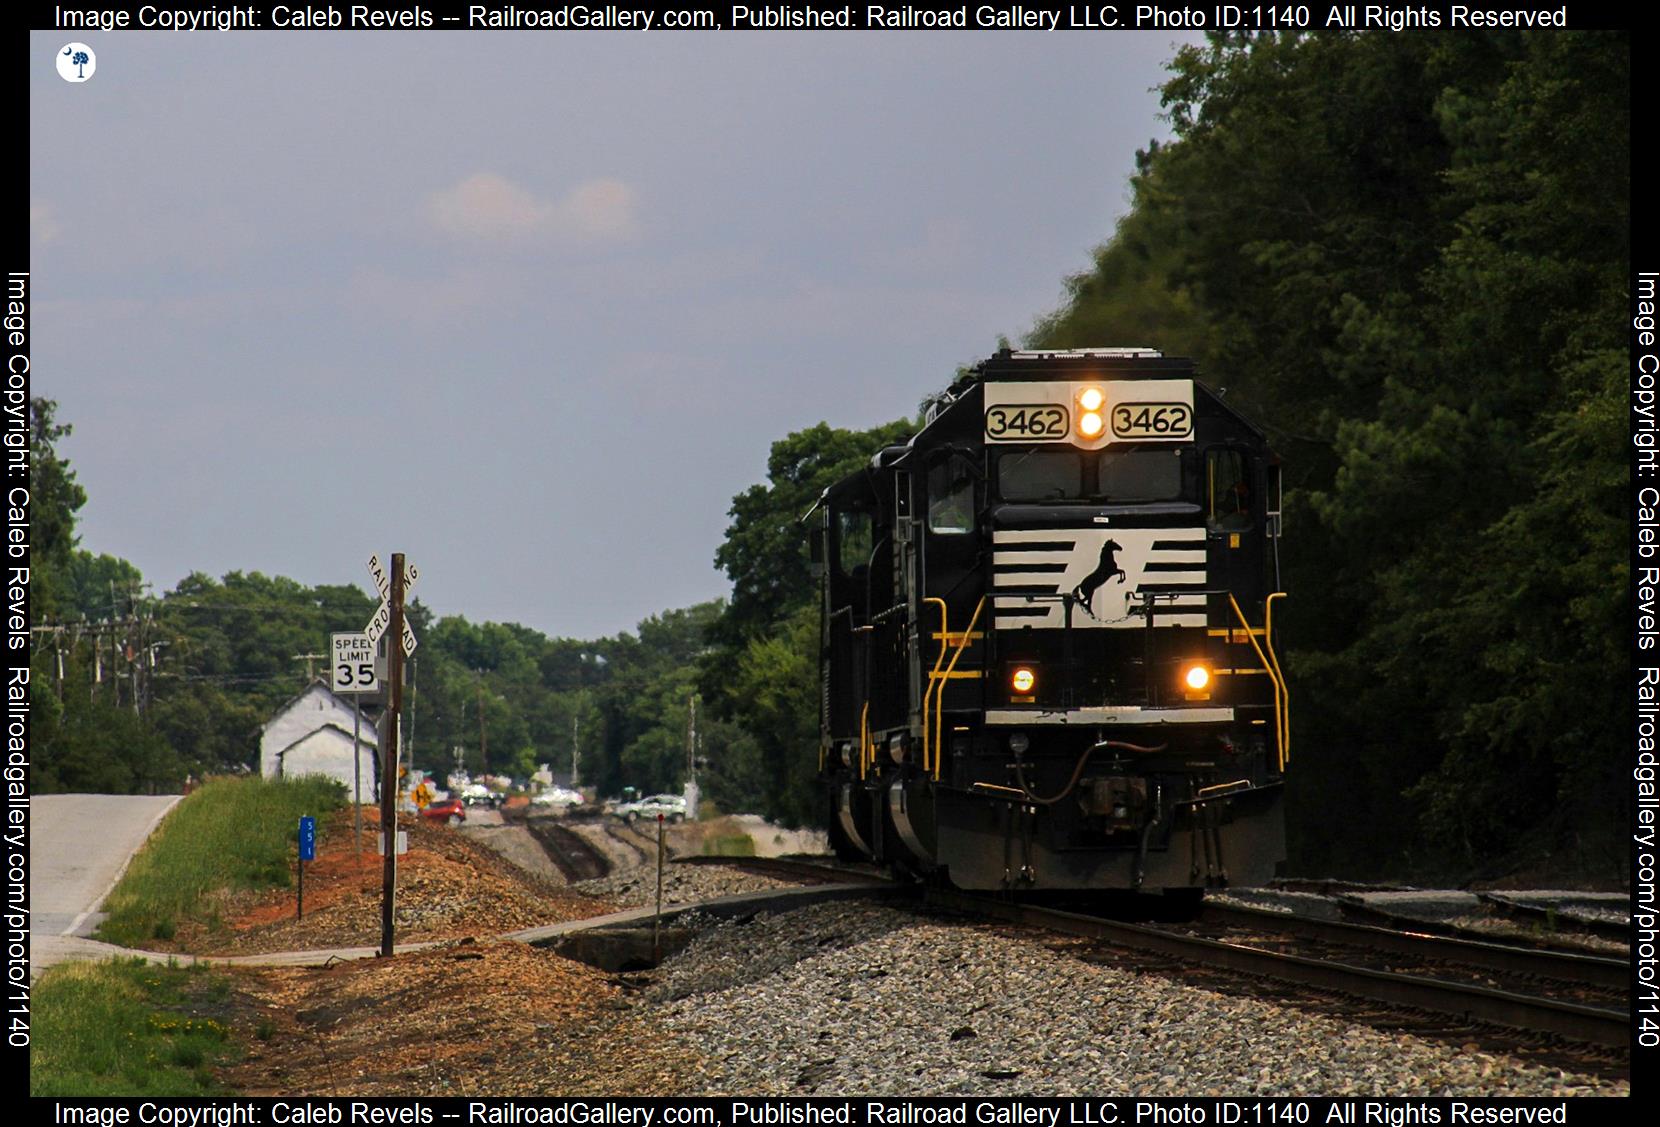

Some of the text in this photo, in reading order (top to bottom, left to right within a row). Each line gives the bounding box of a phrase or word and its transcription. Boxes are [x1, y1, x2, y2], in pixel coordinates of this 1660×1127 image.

[990, 410, 1063, 434] 3462
[1116, 408, 1187, 433] 3462
[369, 556, 414, 651] RAILAD
[340, 652, 370, 661] LIMIT
[338, 664, 374, 685] 35
